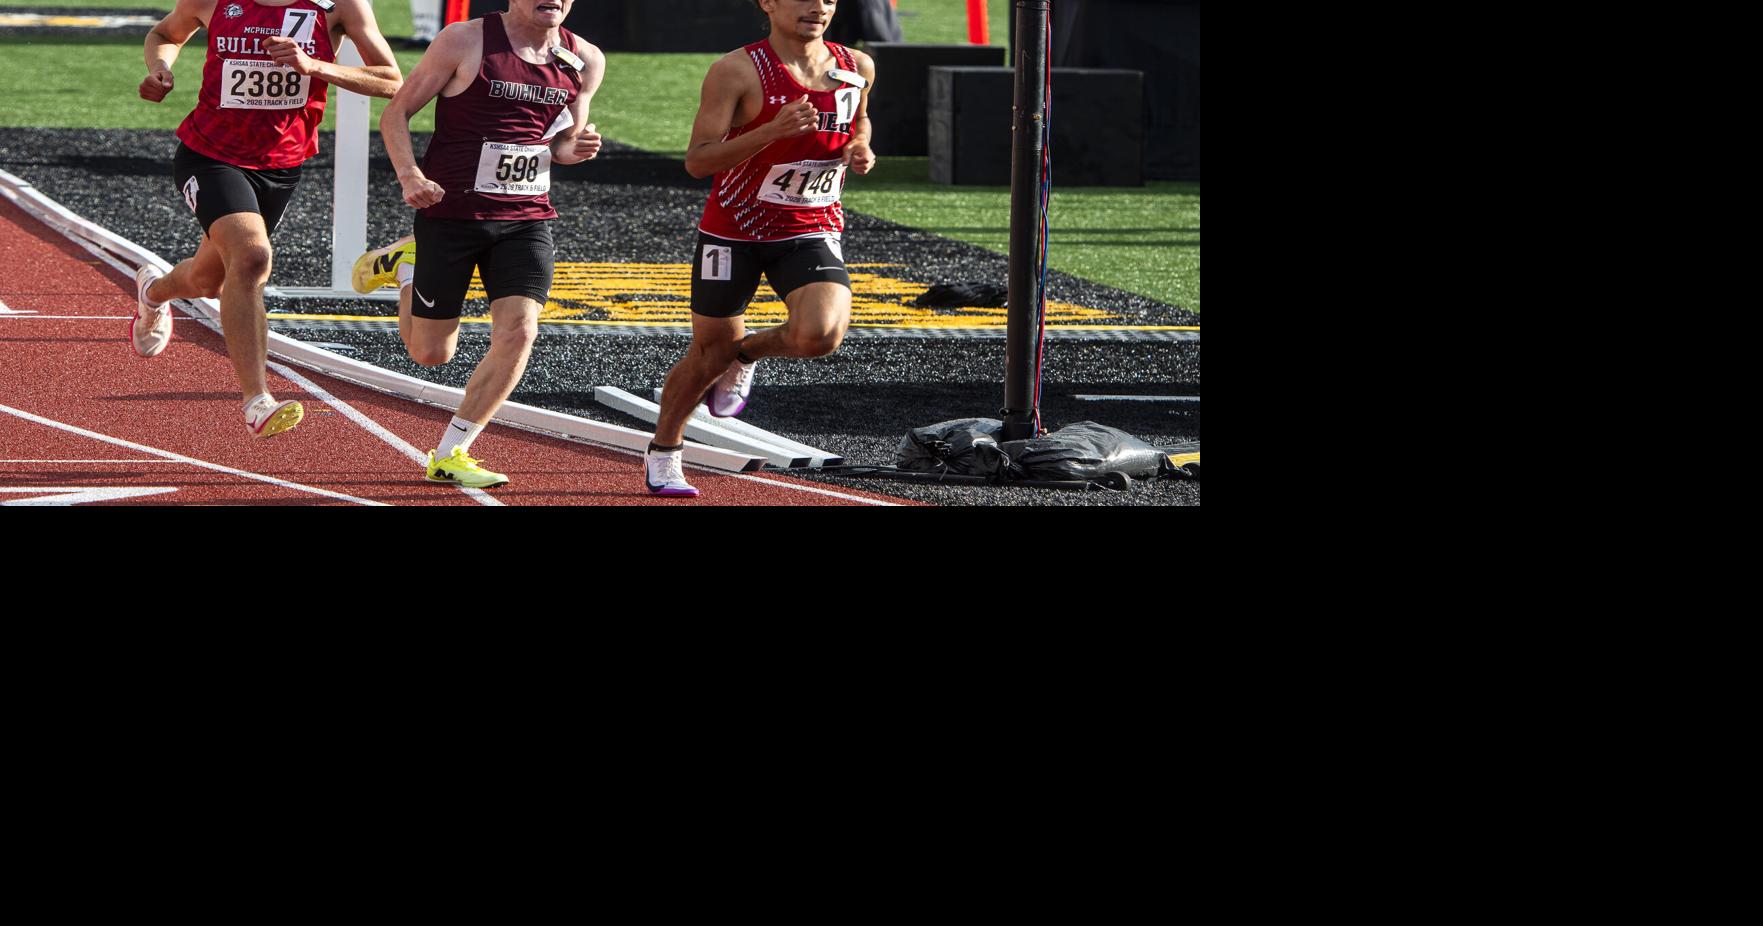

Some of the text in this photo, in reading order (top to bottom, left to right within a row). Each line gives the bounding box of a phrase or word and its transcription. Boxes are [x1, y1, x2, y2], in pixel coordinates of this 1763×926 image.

[244, 27, 281, 35] MCPHERS
[288, 12, 309, 38] 7
[217, 37, 315, 55] BULLS
[230, 69, 302, 98] 2388
[489, 80, 569, 105] BUHLER
[841, 92, 853, 120] 1
[495, 154, 540, 183] 598
[772, 168, 838, 196] 4148
[706, 249, 720, 277] 1
